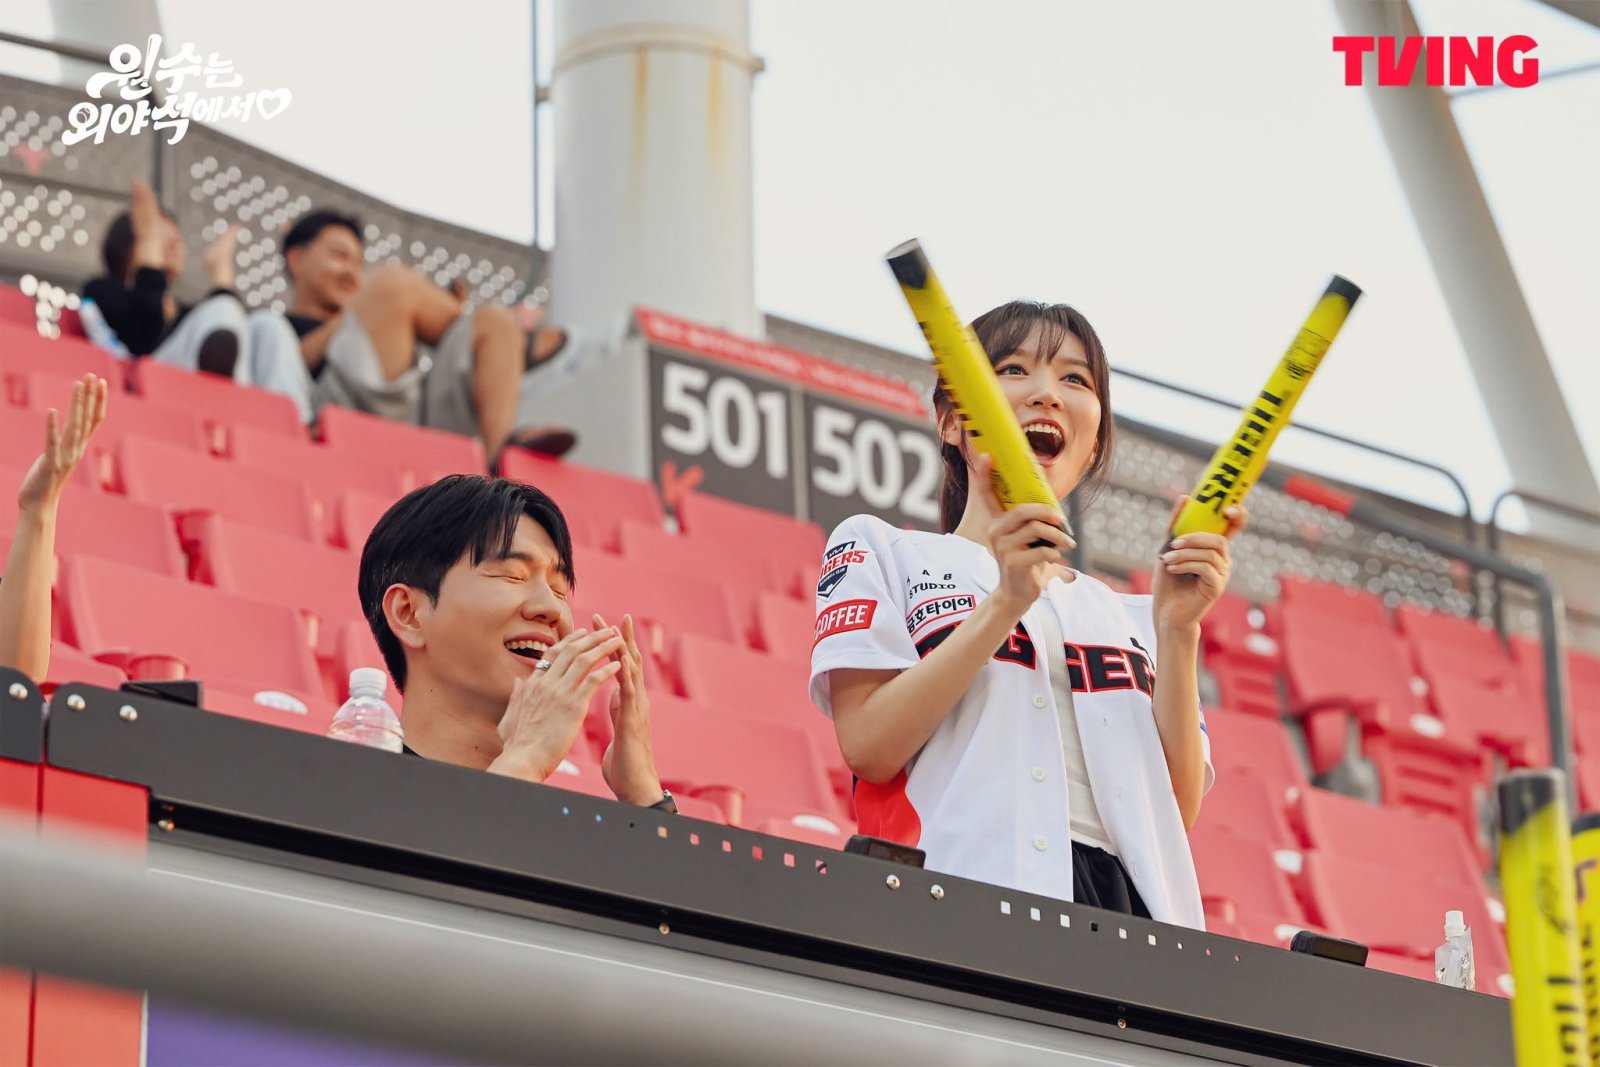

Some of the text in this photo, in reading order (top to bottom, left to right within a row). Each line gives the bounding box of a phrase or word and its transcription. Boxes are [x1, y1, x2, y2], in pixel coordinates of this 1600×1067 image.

[662, 362, 788, 479] 501
[812, 405, 941, 522] 502
[819, 550, 869, 580] IGERS
[909, 582, 957, 599] STUDIO
[814, 604, 869, 641] COFFEE
[906, 596, 973, 634] 금호타이어
